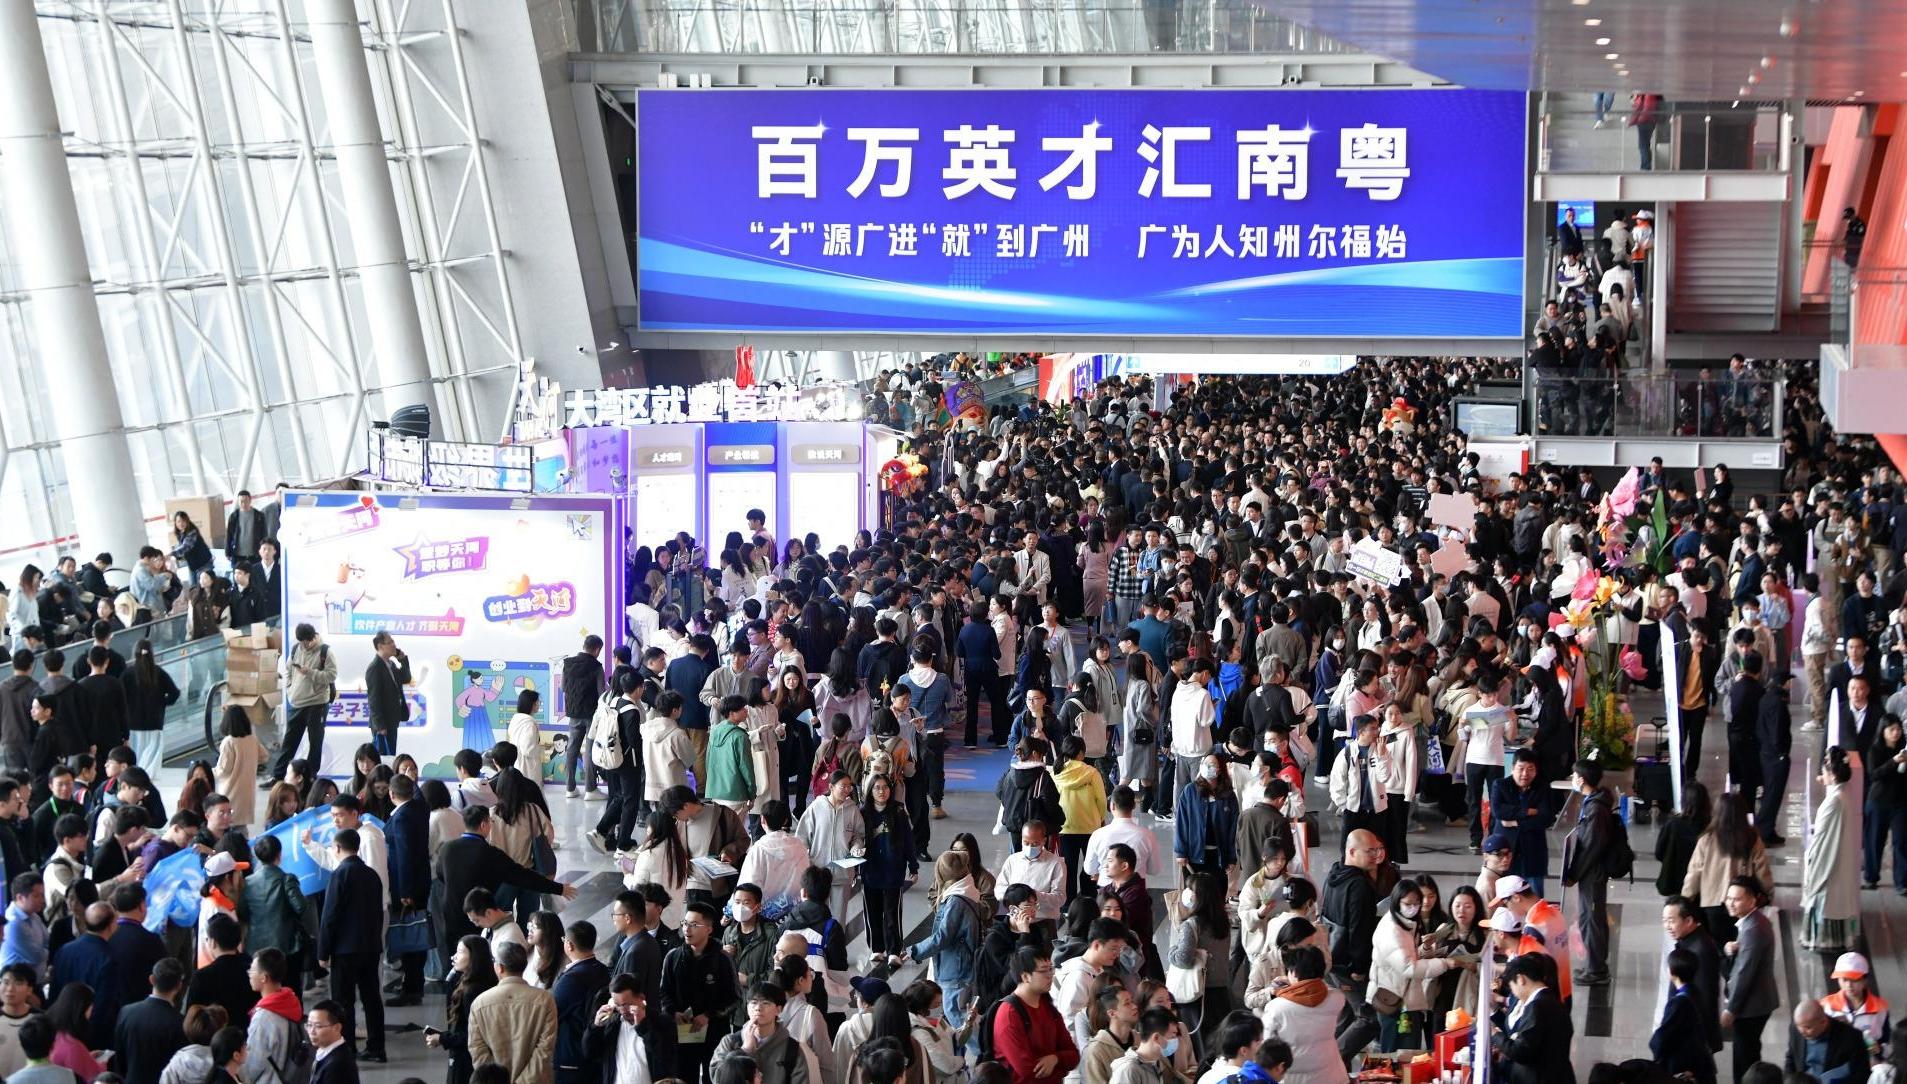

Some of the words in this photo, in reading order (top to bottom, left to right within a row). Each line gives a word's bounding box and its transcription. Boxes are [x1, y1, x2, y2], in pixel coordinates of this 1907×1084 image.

[751, 124, 1412, 202] 百万英才汇南粤
[1137, 222, 1408, 260] 广为人知州尔福始
